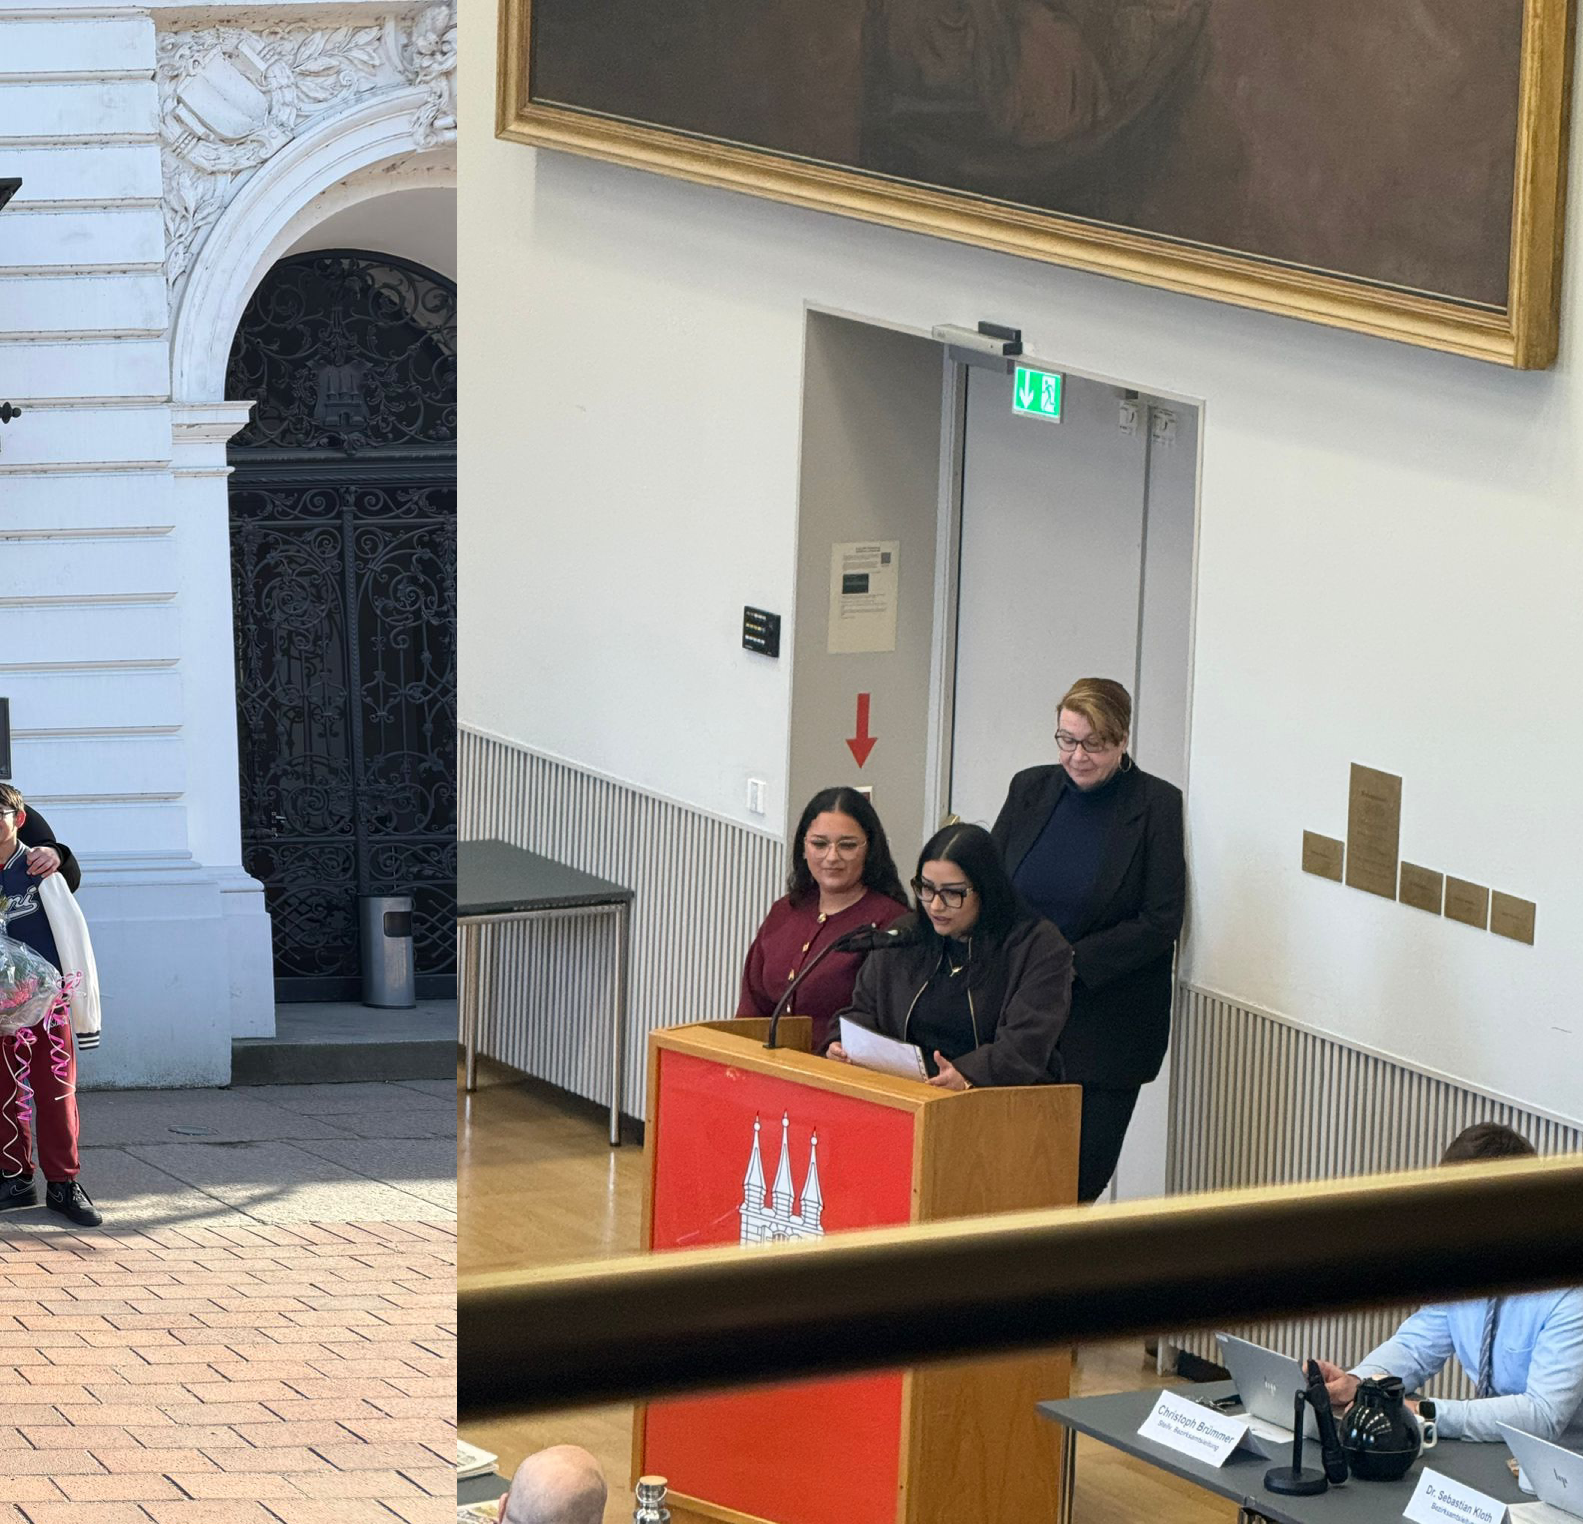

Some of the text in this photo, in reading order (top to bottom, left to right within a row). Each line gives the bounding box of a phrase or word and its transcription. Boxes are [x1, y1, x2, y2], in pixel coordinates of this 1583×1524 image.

[1157, 1404, 1234, 1444] Christoph Brümmer
[1426, 1485, 1493, 1523] Dr. Sebastian Kloth
